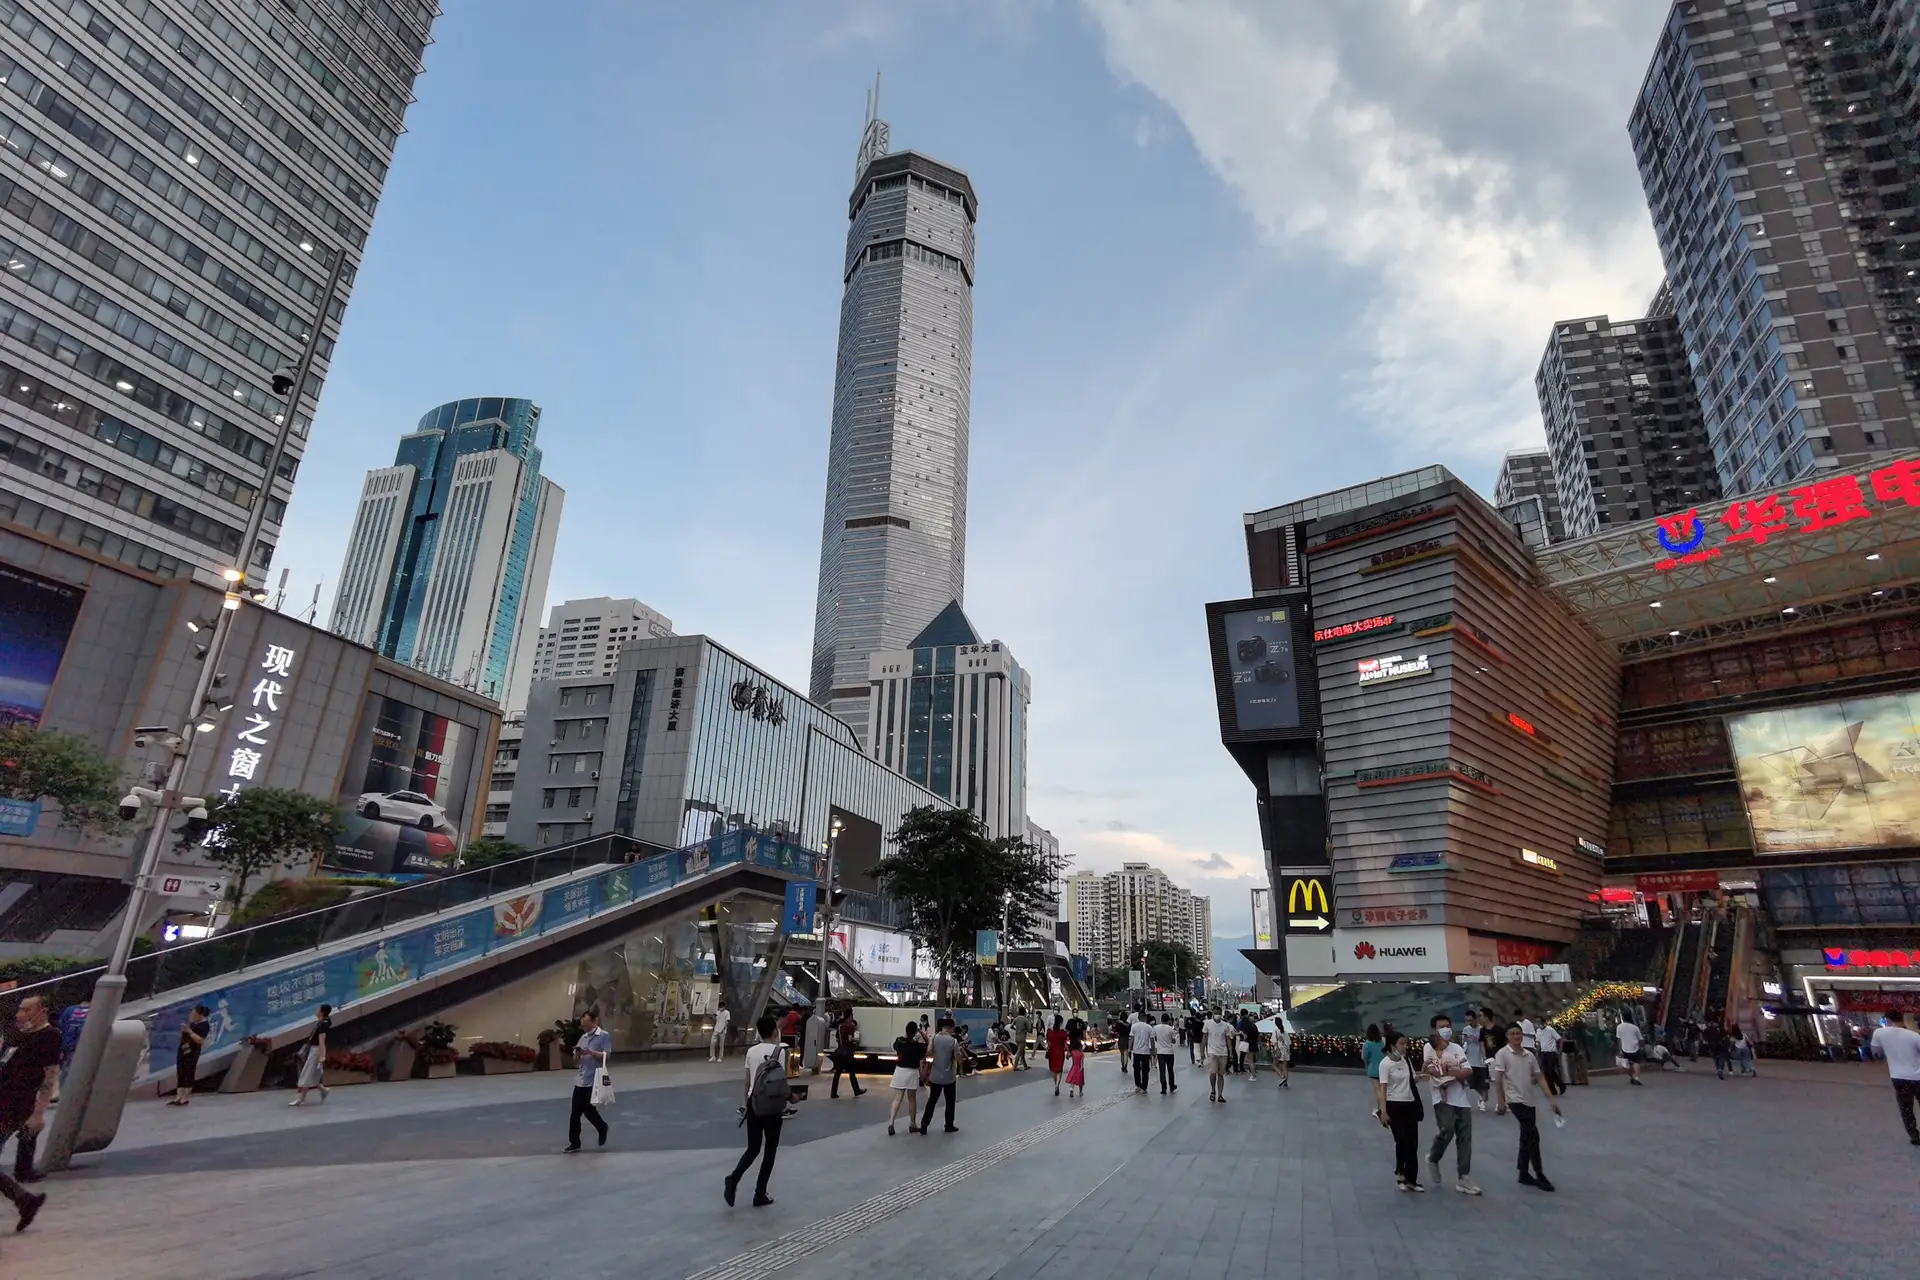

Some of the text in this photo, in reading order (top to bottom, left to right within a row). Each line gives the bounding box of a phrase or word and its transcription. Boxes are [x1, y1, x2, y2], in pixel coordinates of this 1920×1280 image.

[959, 643, 1000, 656] 宝华大厦
[1388, 659, 1430, 677] MUSEUM
[1379, 946, 1427, 957] HUAWEI
